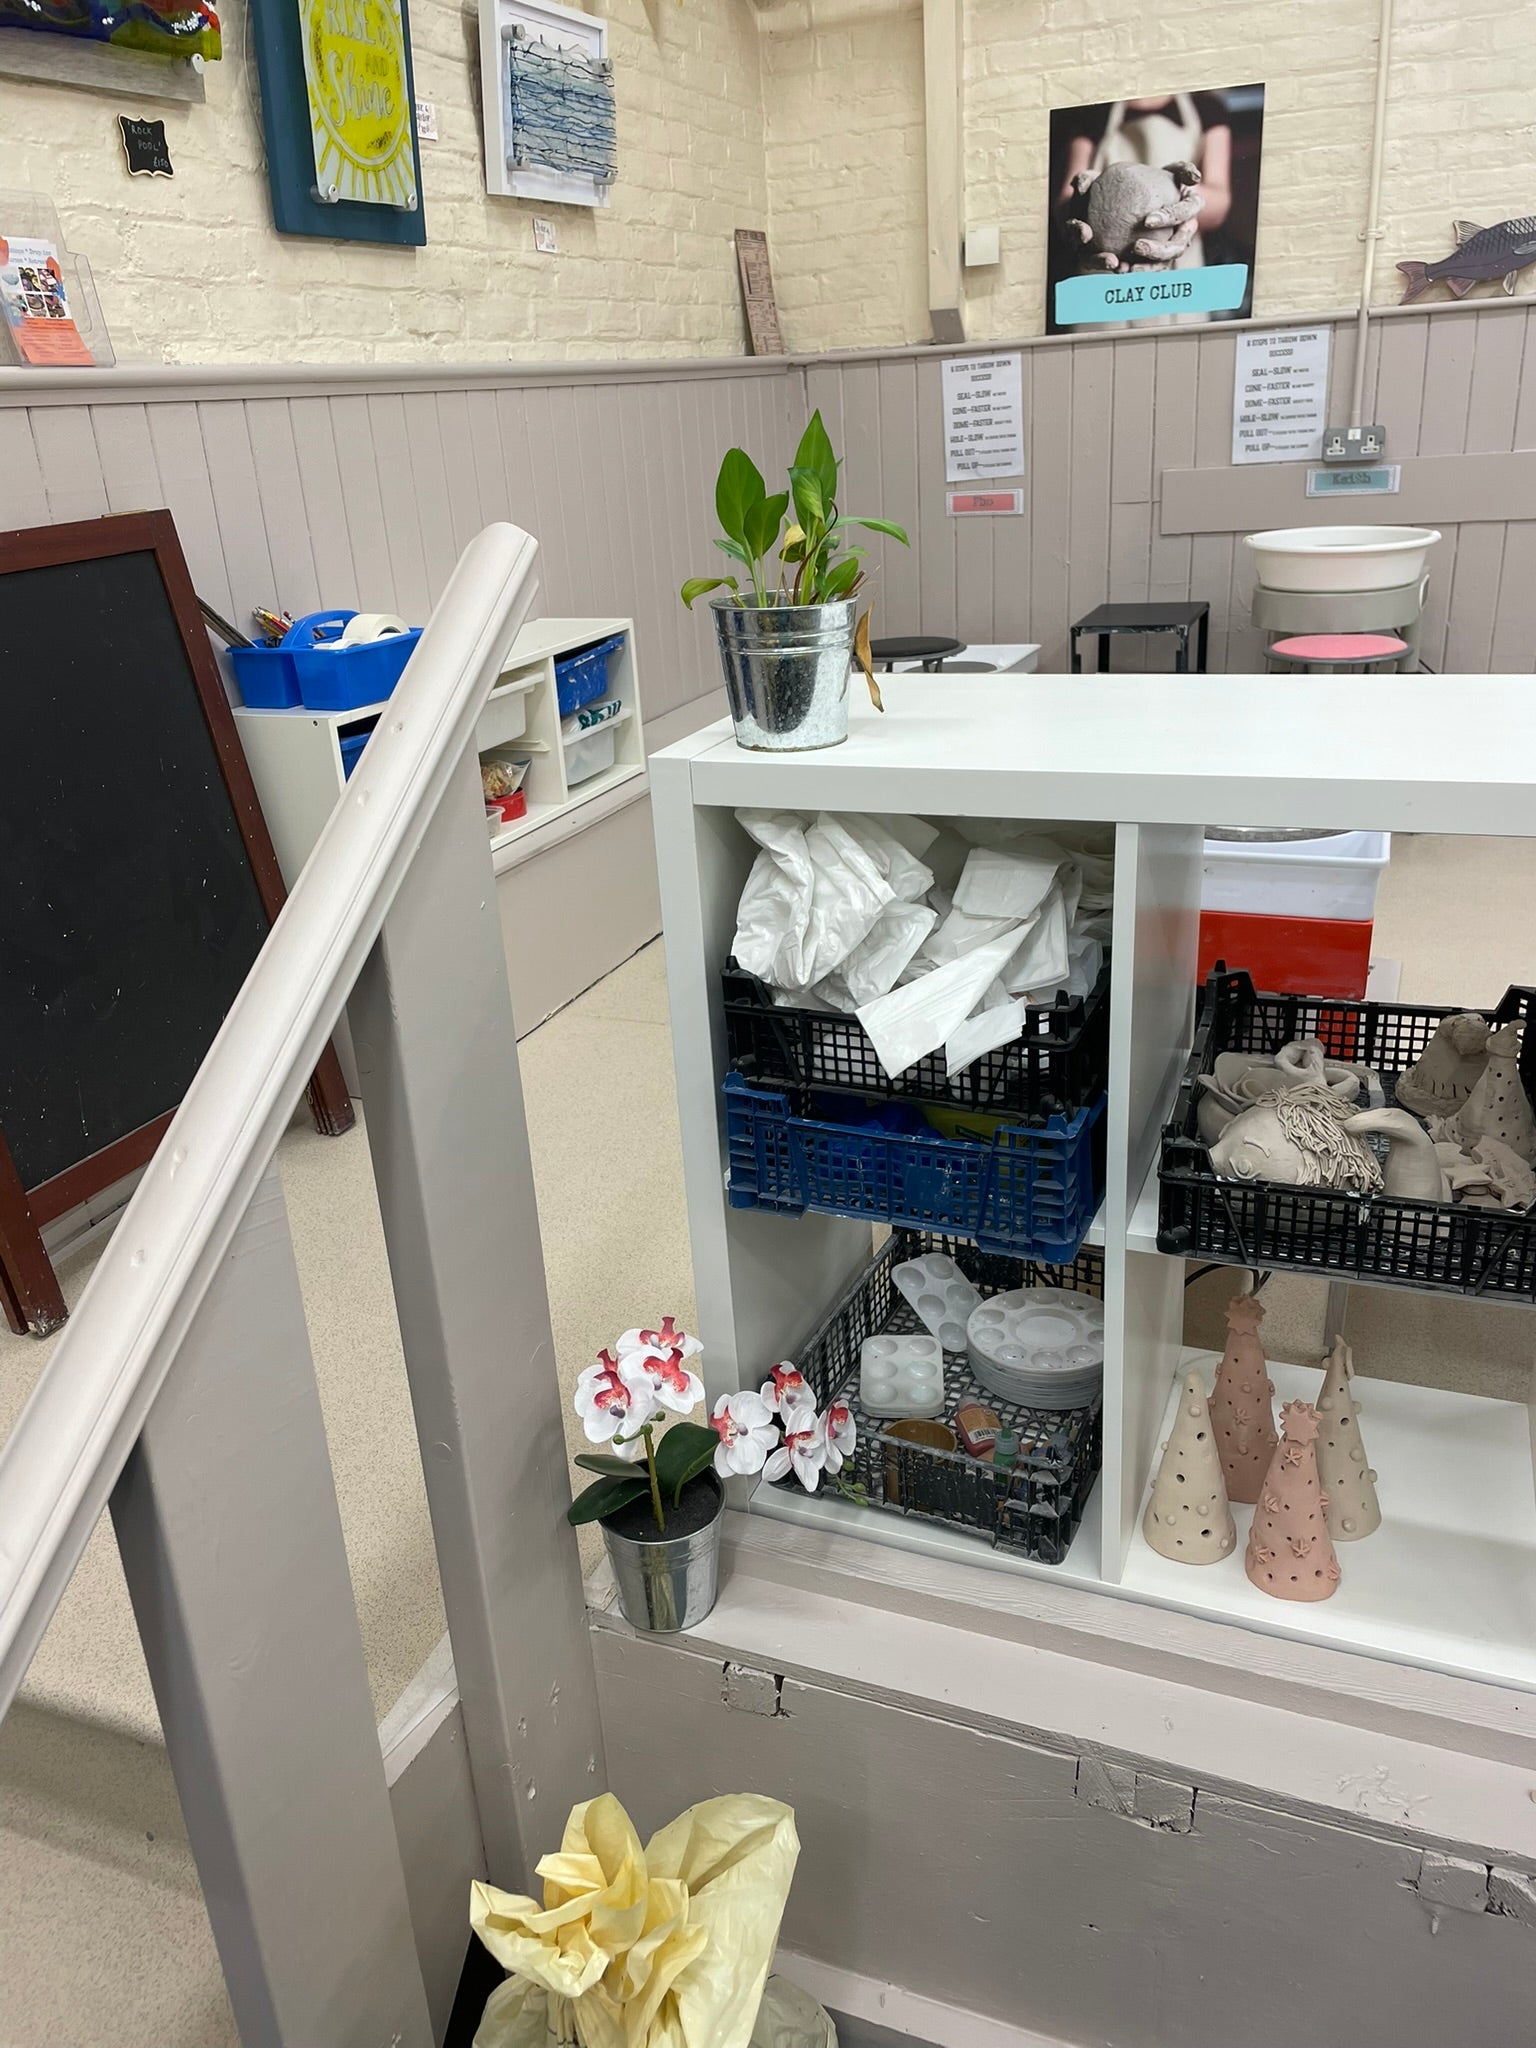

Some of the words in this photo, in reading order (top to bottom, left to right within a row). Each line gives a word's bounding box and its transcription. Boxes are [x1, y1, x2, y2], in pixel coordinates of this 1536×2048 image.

[327, 50, 395, 127] Shine
[1105, 286, 1145, 304] CLAY
[1149, 282, 1192, 300] CLUB
